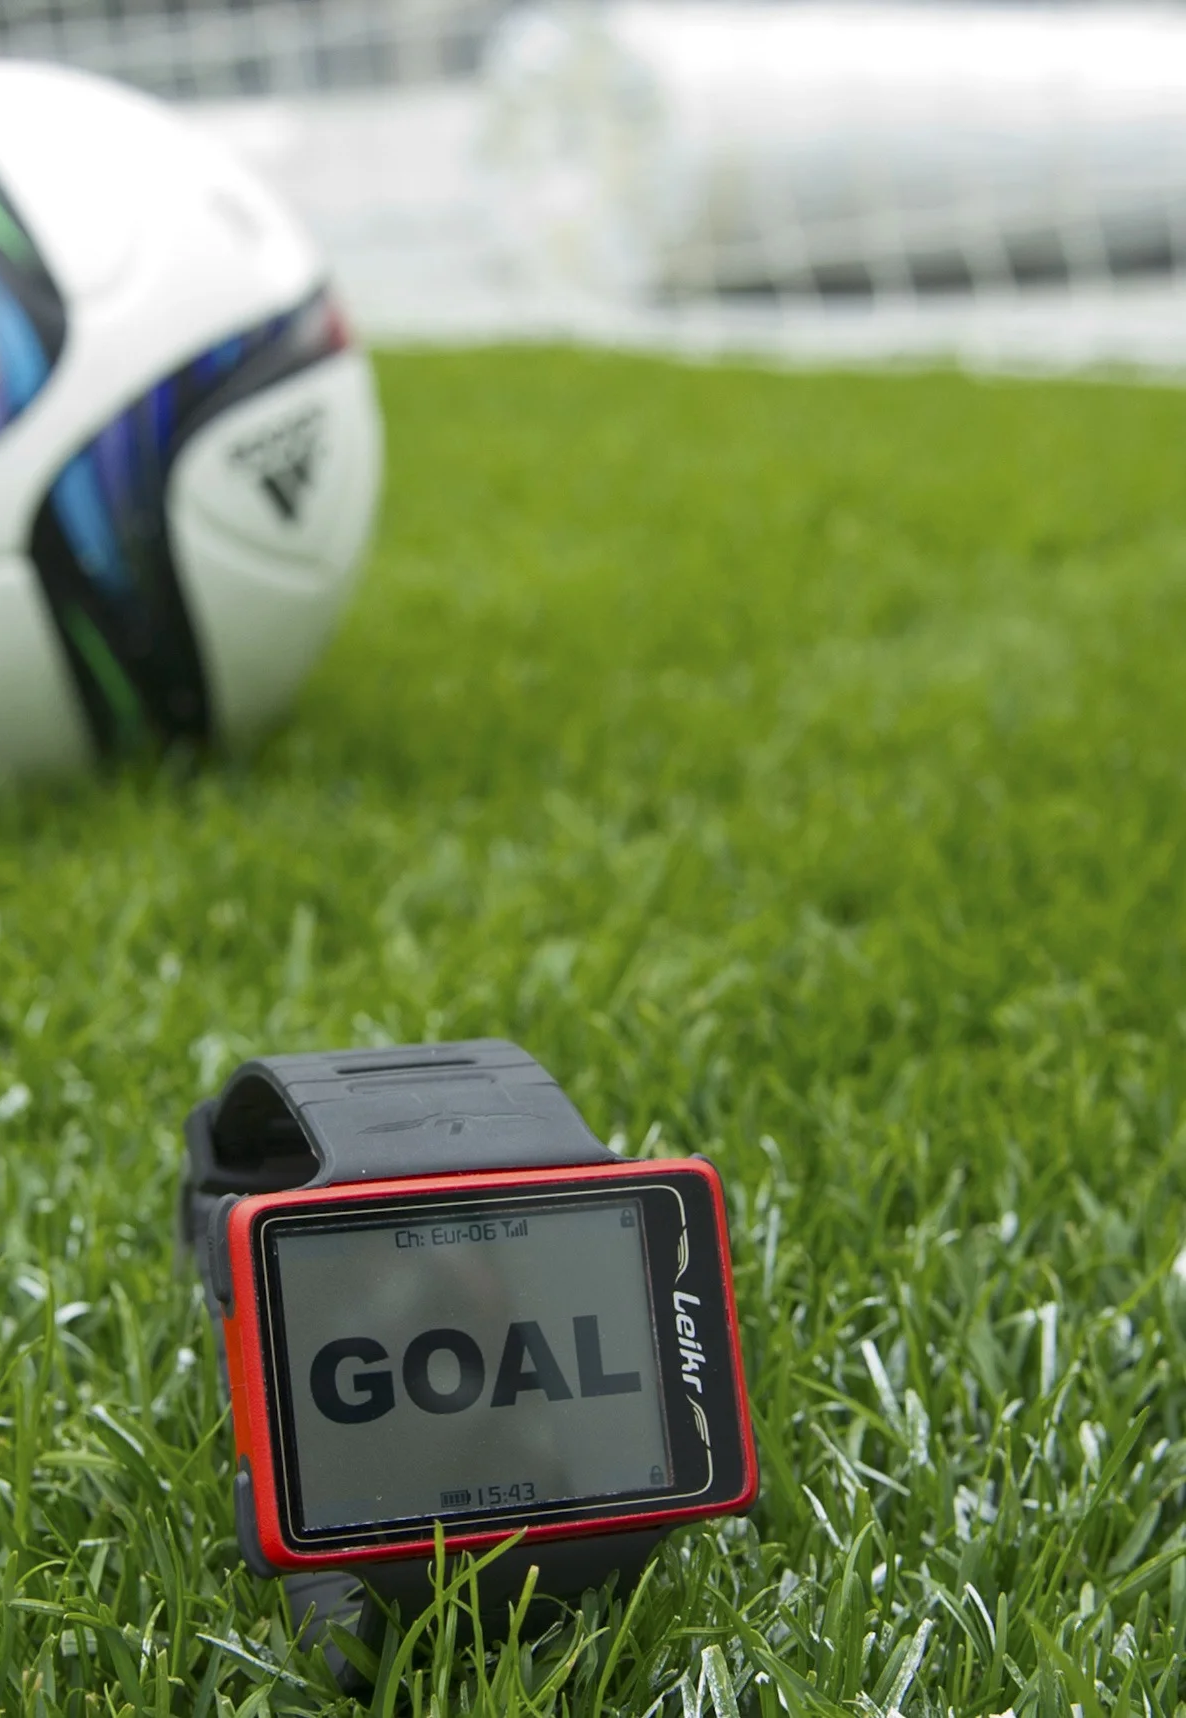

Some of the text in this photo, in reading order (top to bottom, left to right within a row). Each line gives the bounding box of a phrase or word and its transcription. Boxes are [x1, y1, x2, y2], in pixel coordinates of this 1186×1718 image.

[395, 1223, 497, 1248] Ch: Eur-06
[309, 1314, 642, 1425] GOAL
[673, 1290, 706, 1394] Leikr
[478, 1482, 536, 1506] 15:43
